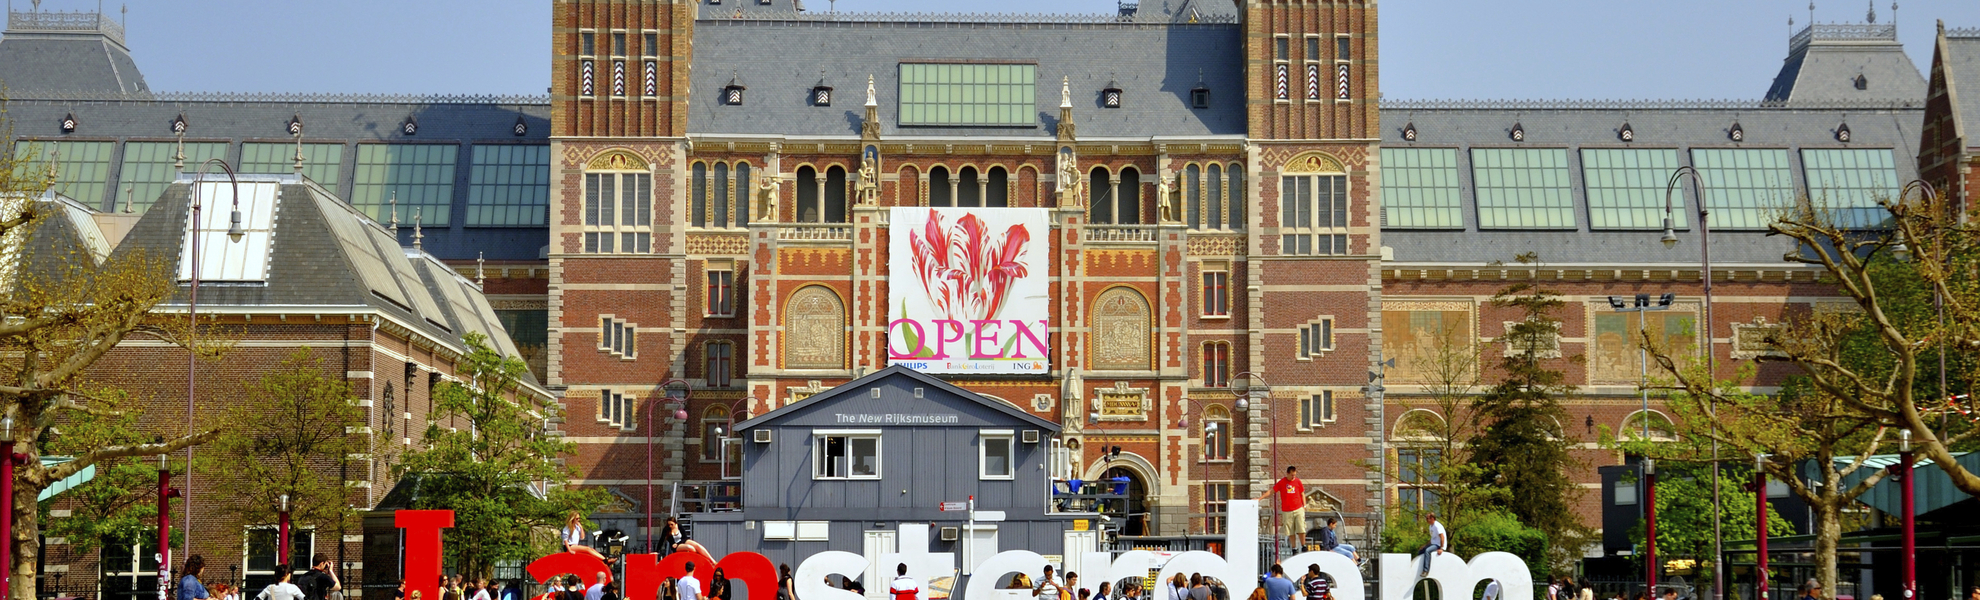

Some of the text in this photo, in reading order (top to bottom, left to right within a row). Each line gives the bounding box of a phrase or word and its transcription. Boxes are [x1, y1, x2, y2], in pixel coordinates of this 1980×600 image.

[889, 318, 1048, 359] OPEN
[1012, 362, 1031, 370] ING
[835, 413, 959, 426] The New Rijksmuseum
